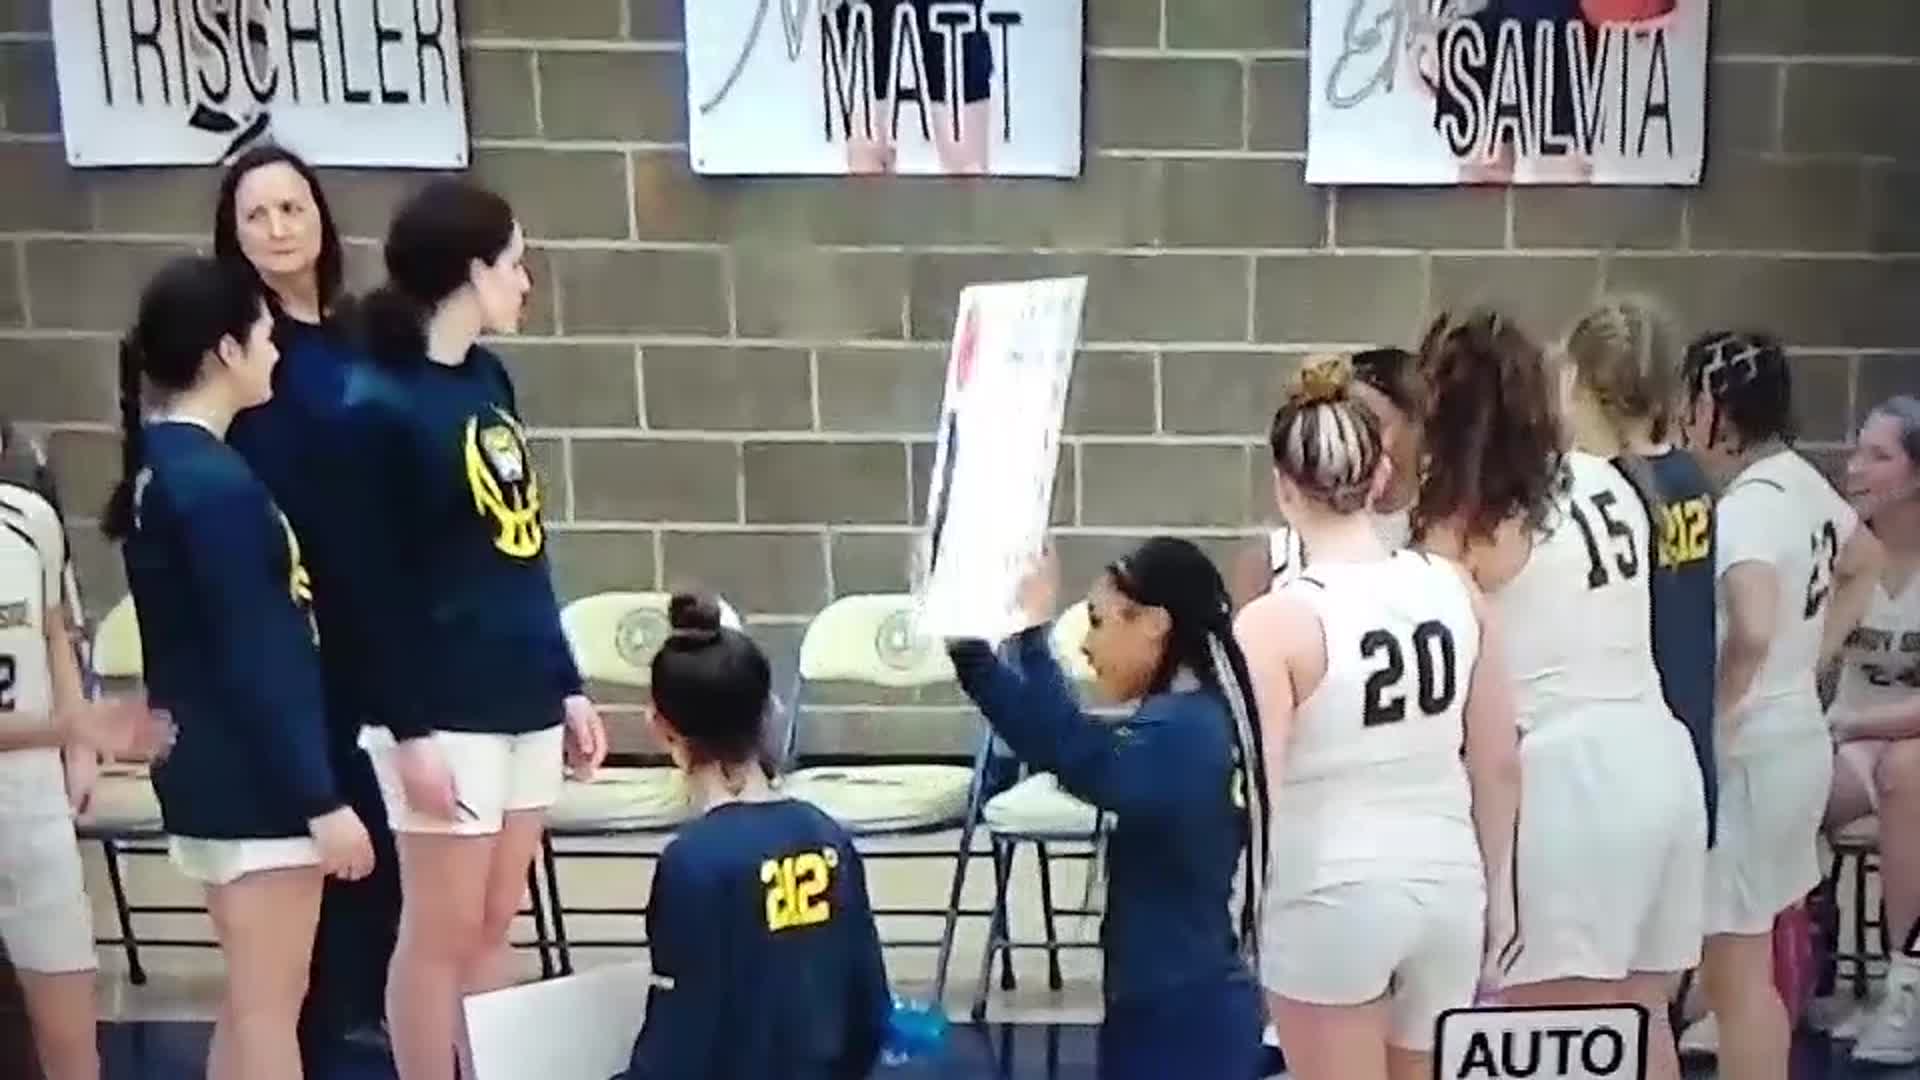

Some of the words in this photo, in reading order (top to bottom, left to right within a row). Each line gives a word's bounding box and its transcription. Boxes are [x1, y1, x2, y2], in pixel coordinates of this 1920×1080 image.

[820, 11, 1023, 143] MATT
[1438, 20, 1674, 158] SALVIA
[1570, 488, 1638, 589] 15
[1360, 619, 1456, 727] 20
